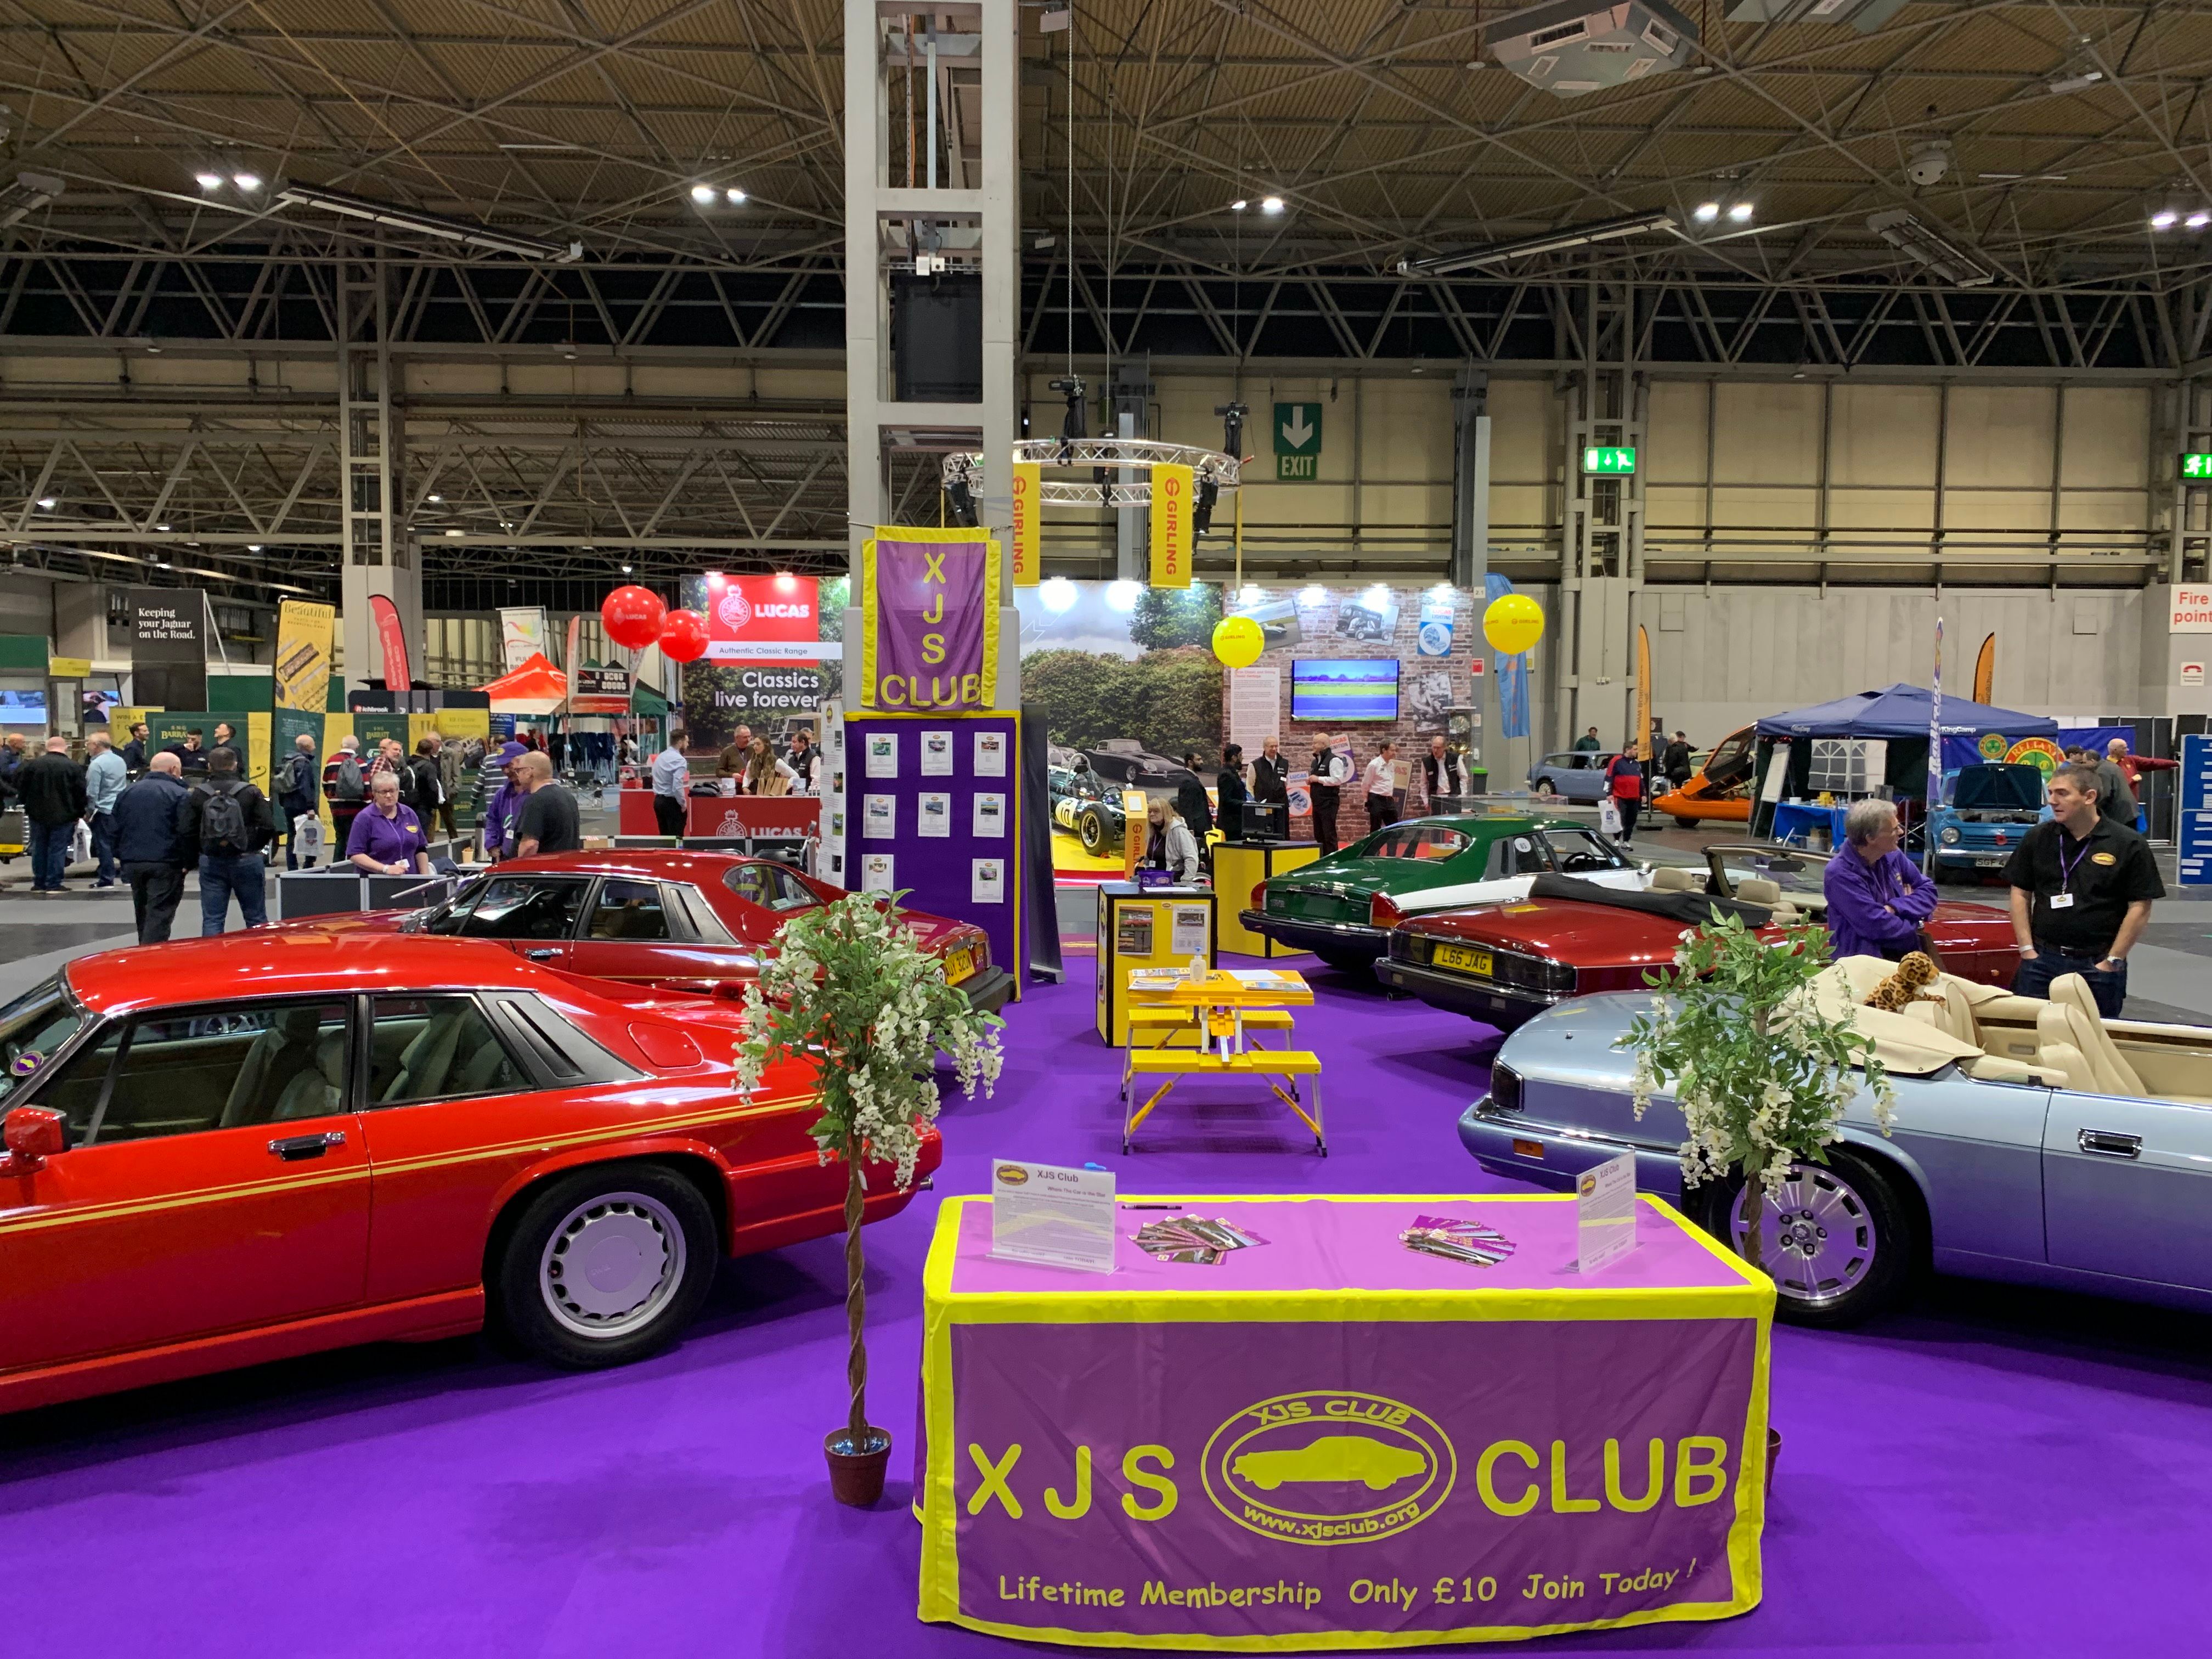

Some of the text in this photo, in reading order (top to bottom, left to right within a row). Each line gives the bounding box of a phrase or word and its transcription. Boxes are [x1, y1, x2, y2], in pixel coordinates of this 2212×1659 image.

[1281, 456, 1313, 476] EXIT
[1013, 499, 1024, 574] GIRLING
[1166, 500, 1177, 575] GIRLING
[2179, 591, 2209, 605] Fire
[138, 607, 176, 619] Keeping
[284, 603, 332, 619] Beautiful
[754, 603, 810, 618] LUCAS
[2174, 610, 2212, 625] point
[138, 619, 191, 630] your Jaguar
[153, 629, 168, 639] the
[170, 629, 196, 639] Road.
[742, 672, 819, 689] Classics
[881, 673, 981, 707] CLUB
[715, 691, 820, 708] live forever
[161, 730, 188, 740] BARRA
[1940, 726, 1976, 734] KingCamp
[751, 827, 802, 837] LUCAS
[1442, 947, 1488, 970] L66 JAG
[1037, 1170, 1079, 1182] XJS Club
[1249, 1400, 1411, 1425] XJS CLUB
[1476, 1435, 1728, 1517] CLUB
[1244, 1502, 1421, 1539] www.xjsclub.org
[998, 1575, 1125, 1607] Lifetime
[1140, 1581, 1322, 1610] Membership
[1348, 1577, 1418, 1612] Only
[1432, 1576, 1498, 1604] £10
[1522, 1573, 1584, 1600] Join
[1600, 1567, 1680, 1595] Today
